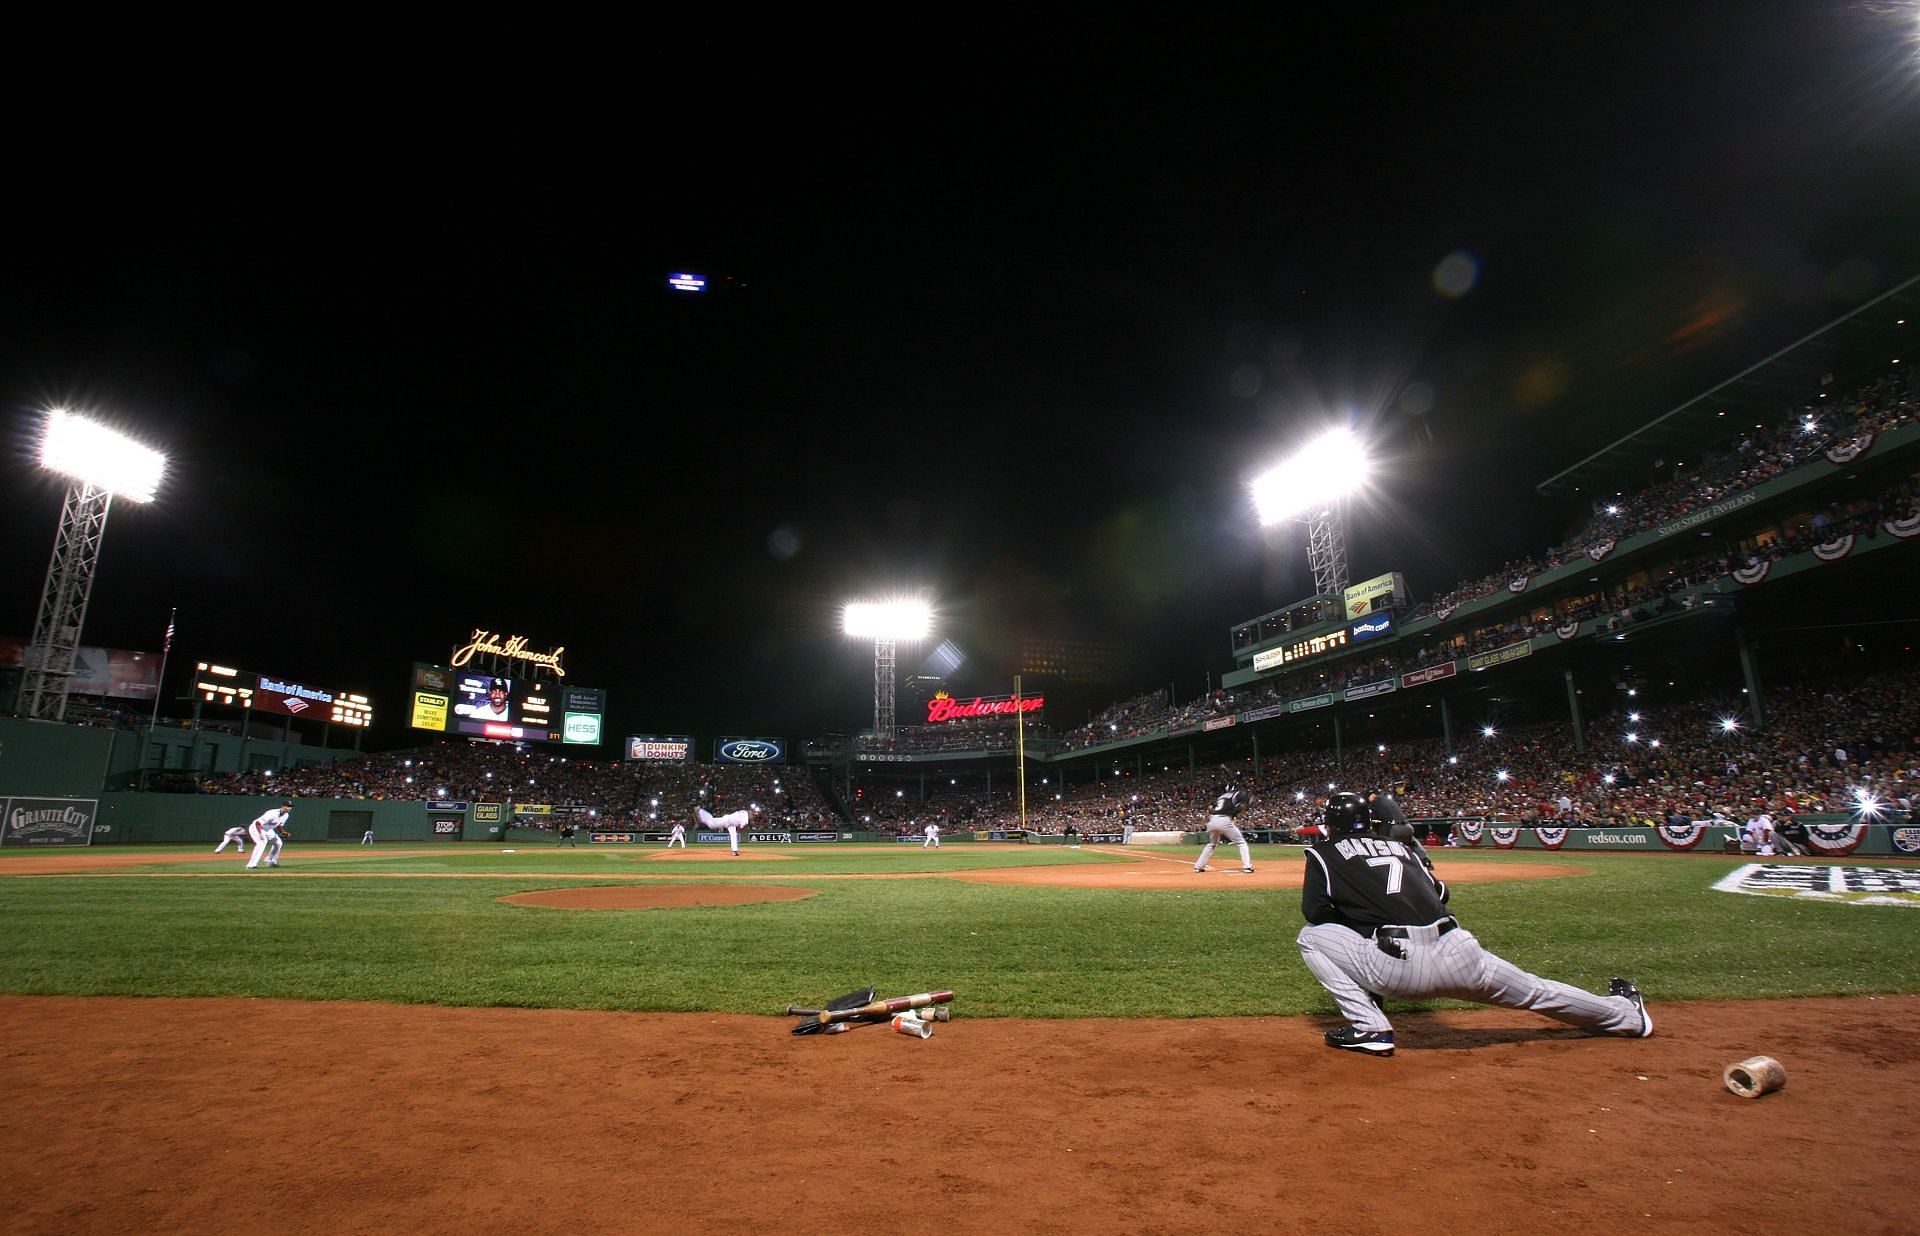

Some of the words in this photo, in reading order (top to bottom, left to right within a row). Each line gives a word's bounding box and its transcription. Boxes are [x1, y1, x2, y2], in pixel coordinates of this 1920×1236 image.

[1658, 523, 1681, 537] STATE
[1681, 510, 1712, 528] STREET
[1712, 494, 1756, 516] PAVILION
[1346, 591, 1361, 601] Bank
[1361, 588, 1368, 596] of
[1368, 580, 1393, 592] America
[452, 628, 502, 667] John
[501, 635, 565, 677] Hancock
[260, 677, 285, 693] Bank
[285, 684, 297, 695] of
[296, 686, 332, 703] America
[928, 694, 1045, 722] Budweiser
[568, 723, 596, 734] HESS
[646, 742, 688, 751] DUNKIN'
[733, 743, 768, 759] Ford
[11, 807, 64, 830] GRANITE
[63, 806, 89, 829] CITY
[522, 805, 544, 813] Nikon
[1587, 831, 1647, 844] redsox.com
[1365, 855, 1404, 895] 7
